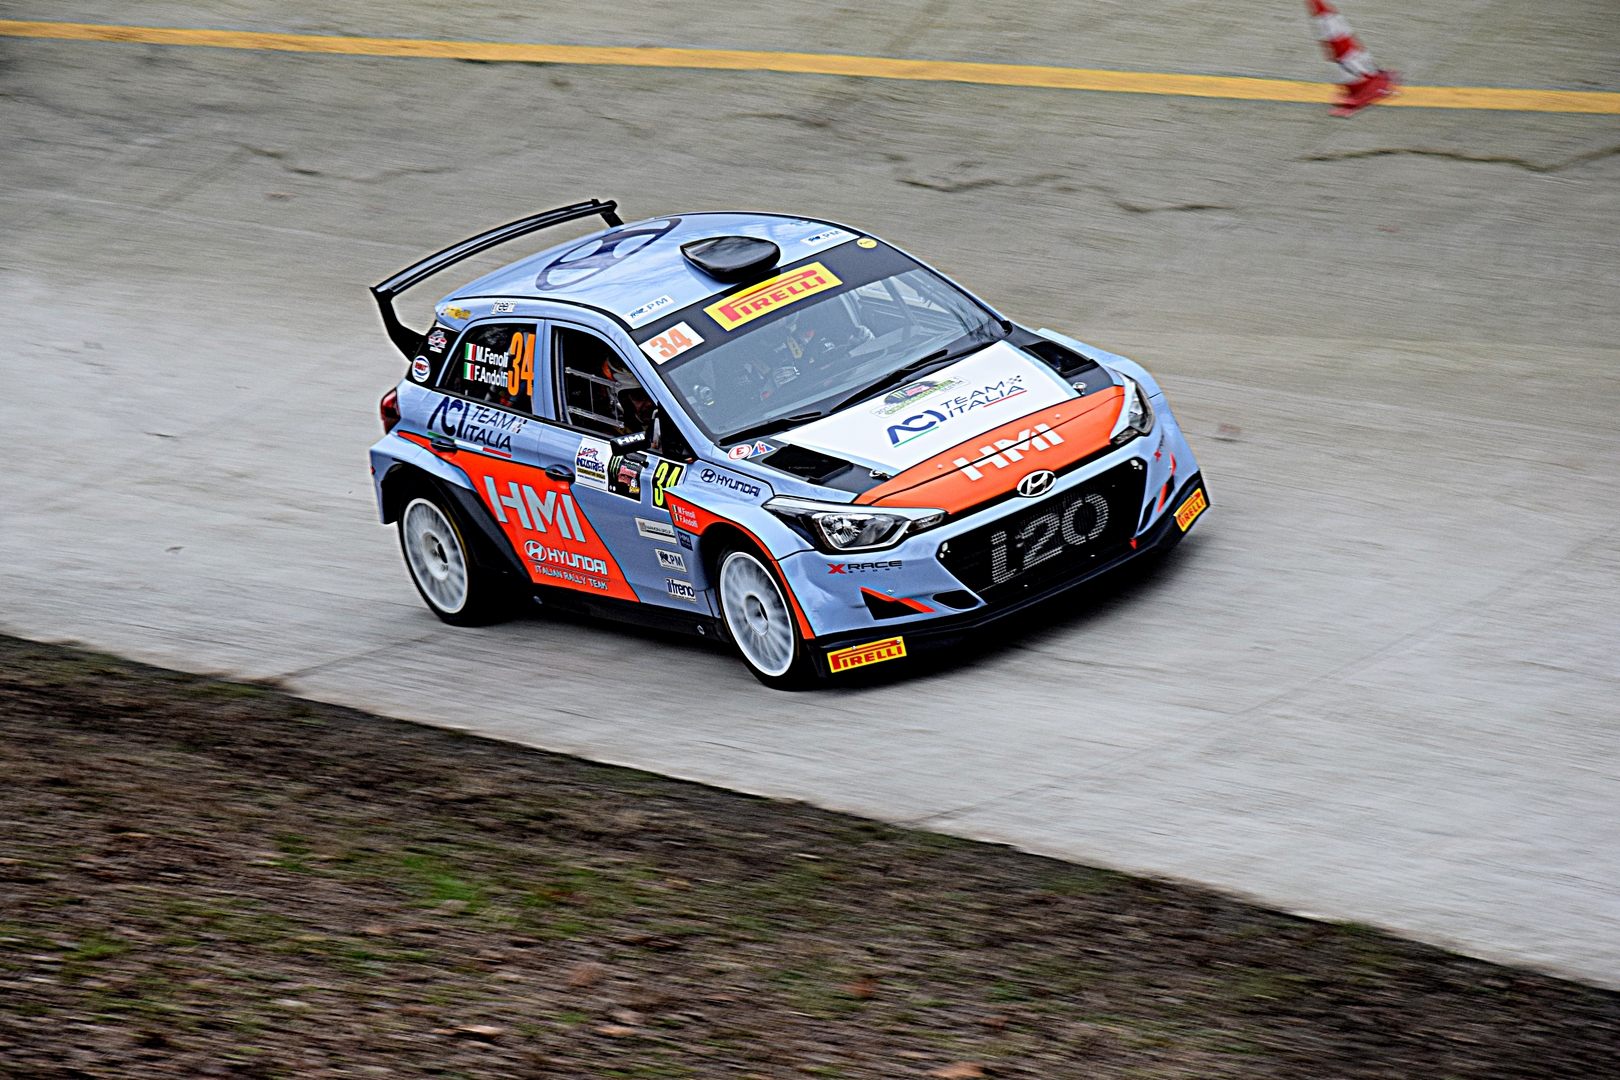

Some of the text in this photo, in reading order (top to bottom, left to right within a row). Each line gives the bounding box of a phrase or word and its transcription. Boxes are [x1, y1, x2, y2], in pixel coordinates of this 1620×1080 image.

[646, 297, 669, 311] PM
[718, 269, 827, 322] PIRELLI
[475, 345, 509, 368] M.Fenoli
[649, 328, 694, 358] 34
[474, 365, 508, 388] F.Andolfi
[507, 332, 536, 396] 34
[941, 380, 1005, 410] TEAM
[949, 385, 1024, 418] ITALIA
[471, 406, 516, 430] TEAM
[463, 424, 511, 452] ITALIA
[617, 433, 646, 445] HMI
[952, 423, 1065, 482] HMI
[715, 475, 761, 497] HYUNDAI
[483, 475, 587, 543] HMI
[1176, 492, 1206, 528] PIRELLI
[546, 547, 608, 575] HYUNDAI
[534, 564, 609, 591] ITALIAN RALLY TEAM
[830, 640, 903, 671] PIRELLI
